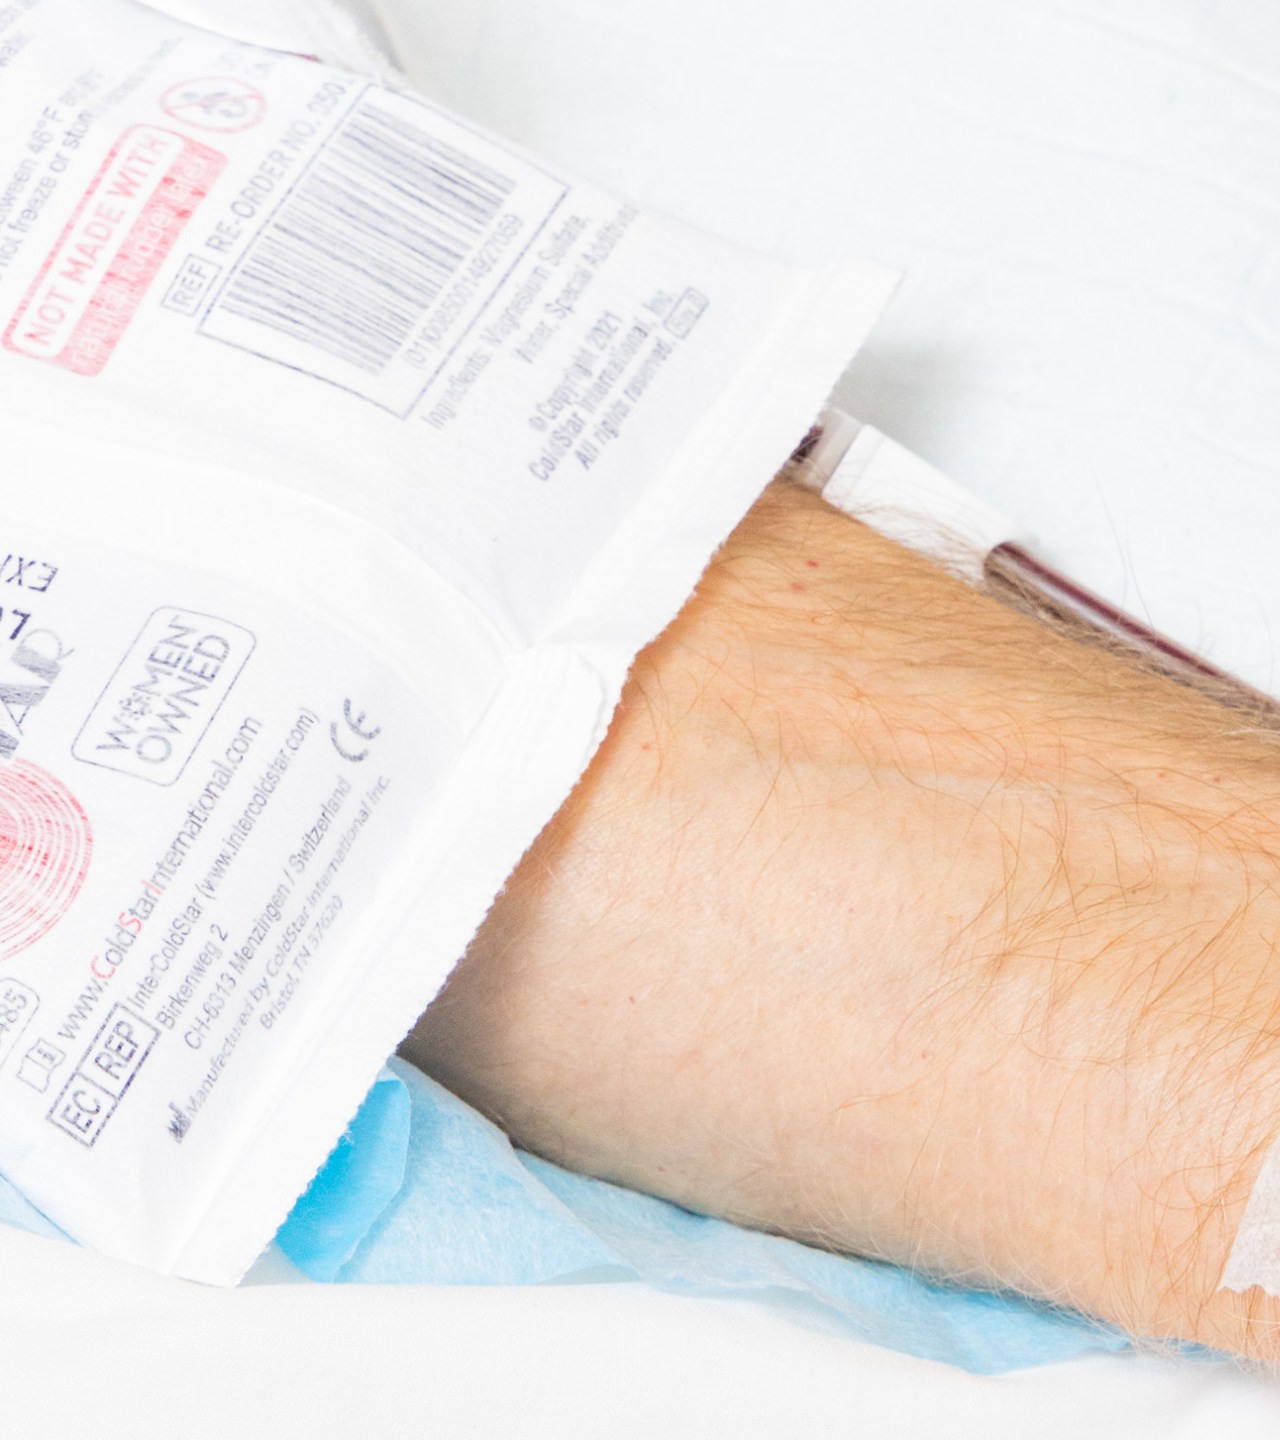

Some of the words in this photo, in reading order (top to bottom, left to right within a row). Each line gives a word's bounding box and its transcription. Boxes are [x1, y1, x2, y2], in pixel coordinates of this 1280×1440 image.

[7, 176, 58, 233] freeze
[49, 151, 70, 173] or
[27, 105, 62, 154] 46°F
[23, 285, 74, 346] NOT
[59, 204, 125, 285] MADE
[106, 137, 168, 198] WITH
[70, 281, 132, 365] natural
[115, 200, 176, 280] rubber
[159, 150, 210, 205] latex
[171, 263, 207, 307] REF
[204, 149, 295, 254] RE-ORDER
[278, 120, 322, 152] NO.
[420, 348, 493, 430] Ingredients:
[479, 265, 552, 347] Magnesium
[544, 264, 594, 320] Special
[528, 411, 586, 482] ColdStar
[574, 439, 599, 470] All
[593, 399, 631, 445] rights
[136, 634, 230, 764] OWNED
[57, 717, 262, 1039] www.ColdStarInternational.com
[127, 897, 204, 1010] InterColdStar
[195, 707, 320, 900] (www.intercoldstar.com)
[184, 972, 236, 1050] CH-6313
[228, 884, 290, 975] Menzingen
[288, 776, 351, 873] Switzerland
[155, 941, 223, 1030] Birkenweg
[210, 924, 228, 942] 2
[185, 999, 254, 1118] Manufactured
[249, 977, 270, 1002] by
[266, 906, 309, 977] ColdStar
[306, 800, 372, 908] International
[259, 972, 300, 1030] Bristol,
[292, 944, 312, 972] TN
[307, 894, 343, 950] 37620
[60, 1090, 101, 1134] EC
[94, 1020, 139, 1080] REP
